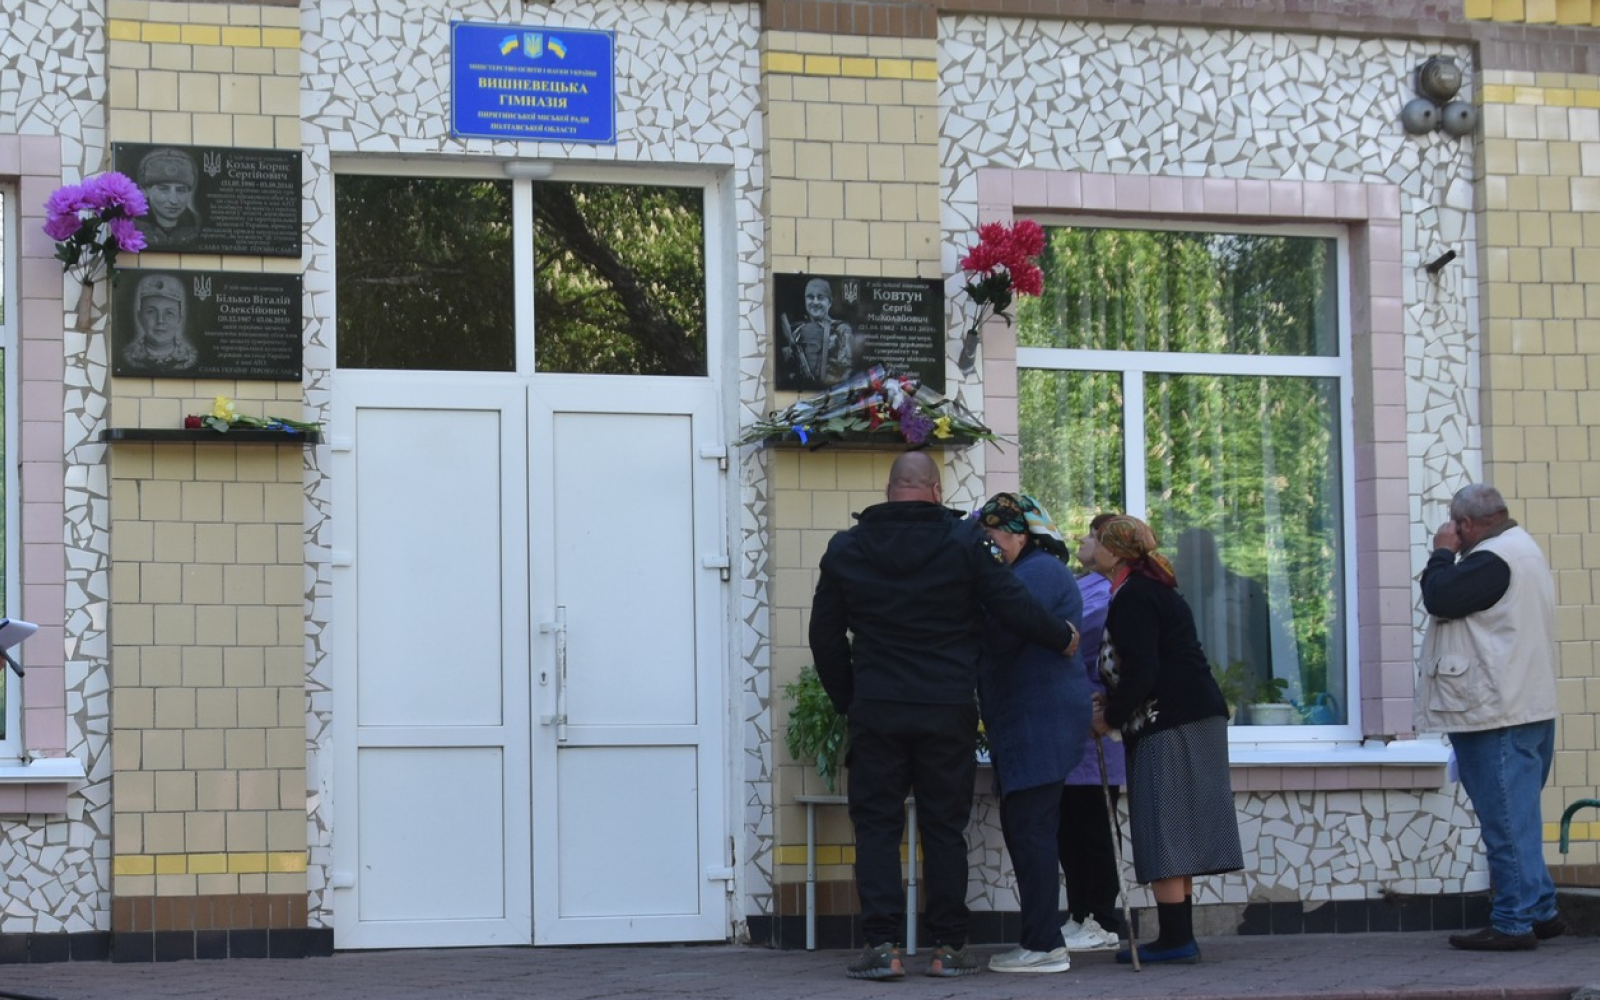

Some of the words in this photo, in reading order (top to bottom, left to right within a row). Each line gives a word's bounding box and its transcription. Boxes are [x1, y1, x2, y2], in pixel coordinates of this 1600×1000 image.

[478, 77, 588, 94] ВИШНЕВЕЦЬКА
[499, 94, 568, 108] ГІМНАЗІЯ
[478, 110, 536, 121] ПИРЯТИНСЬКОЇ
[537, 113, 569, 122] МІСЬКОЇ
[570, 116, 590, 124] РАДИ
[490, 123, 543, 132] ПОЛТАВСЬКОЇ
[544, 126, 577, 134] ОБЛАСТІ
[226, 159, 256, 169] Козак
[259, 161, 291, 172] Борис
[227, 169, 288, 181] Сергійович
[216, 293, 251, 304] Білько
[253, 294, 291, 305] Віталій
[873, 288, 923, 303] Ковтун
[220, 304, 287, 315] Олексійович
[882, 303, 913, 313] Сергій
[867, 313, 929, 324] Миколайович
